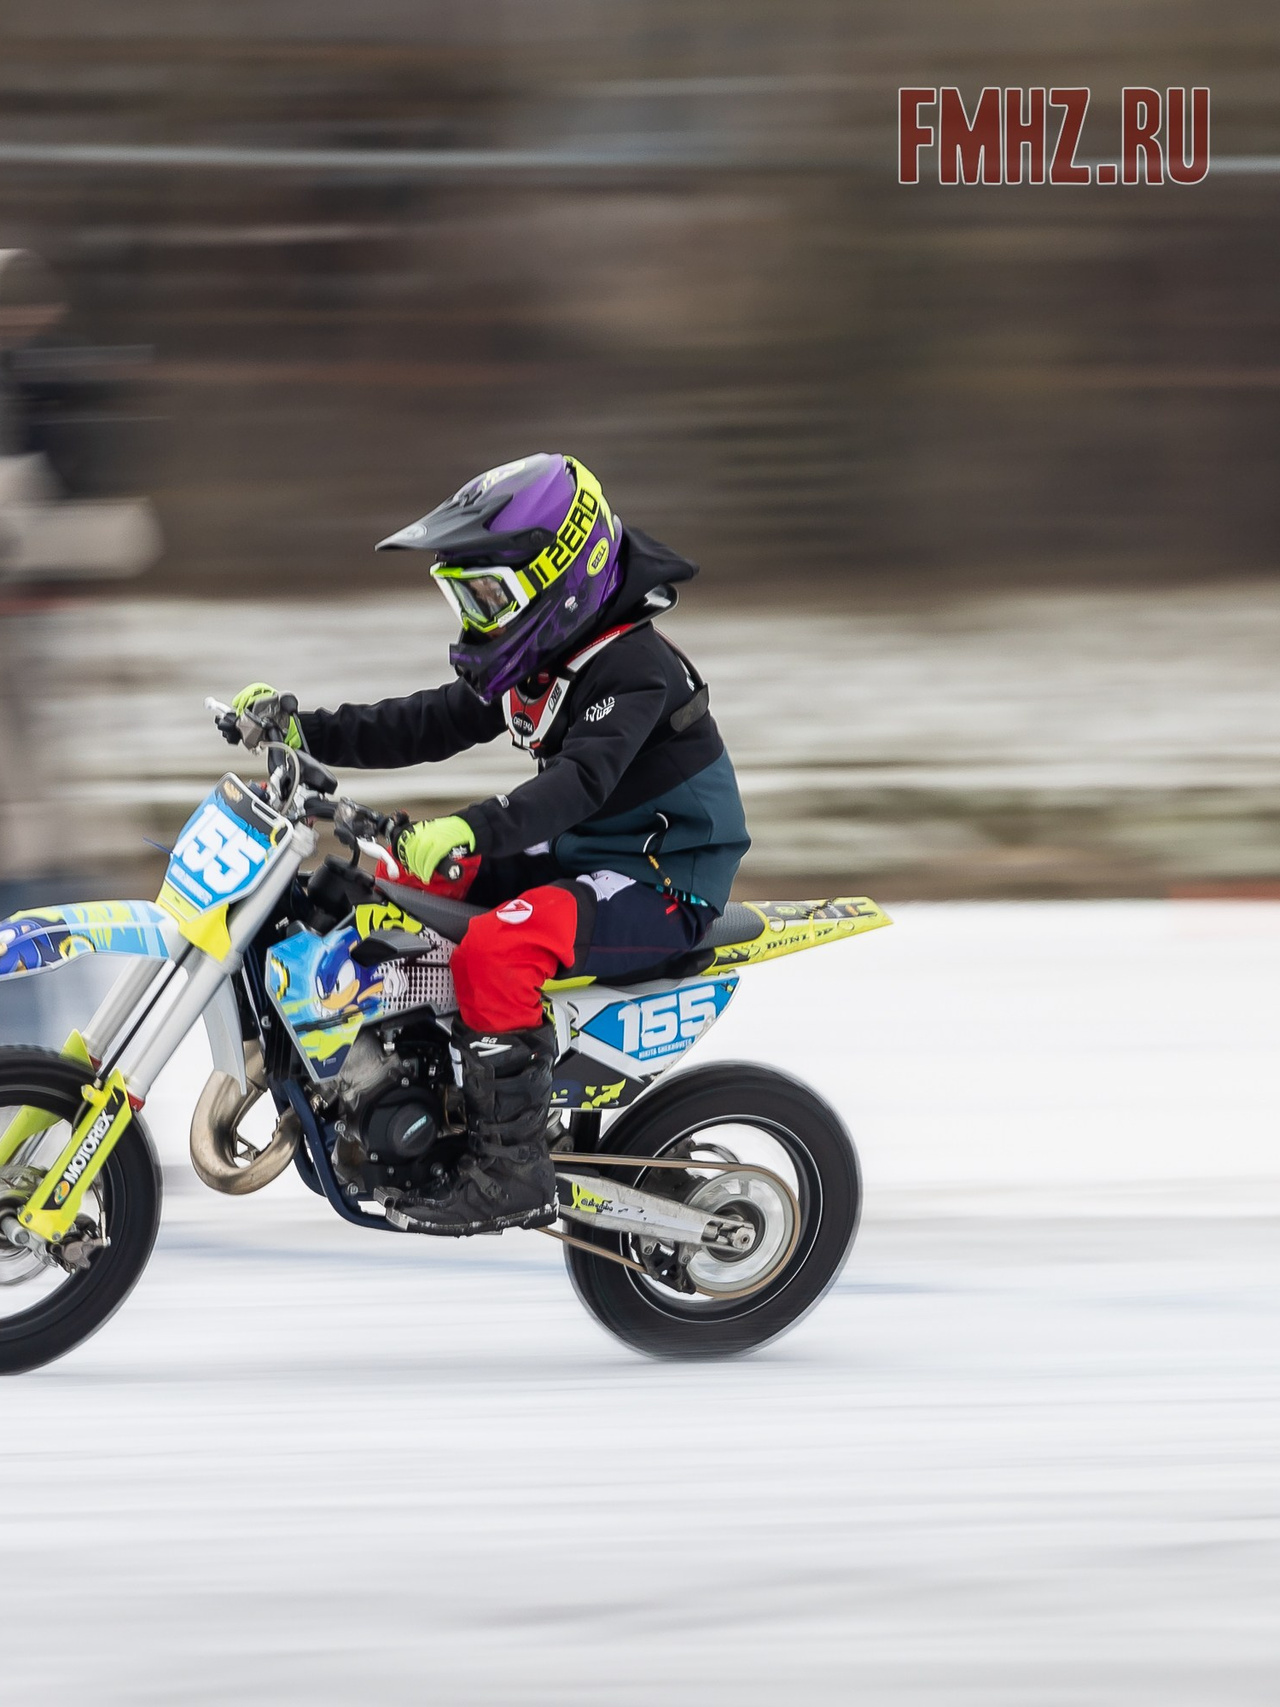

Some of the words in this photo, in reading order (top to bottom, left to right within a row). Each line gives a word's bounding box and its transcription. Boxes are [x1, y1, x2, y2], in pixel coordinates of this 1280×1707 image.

[591, 546, 606, 570] BELL
[173, 803, 267, 895] 155
[618, 985, 717, 1053] 155
[63, 1109, 114, 1184] MOTOREX
